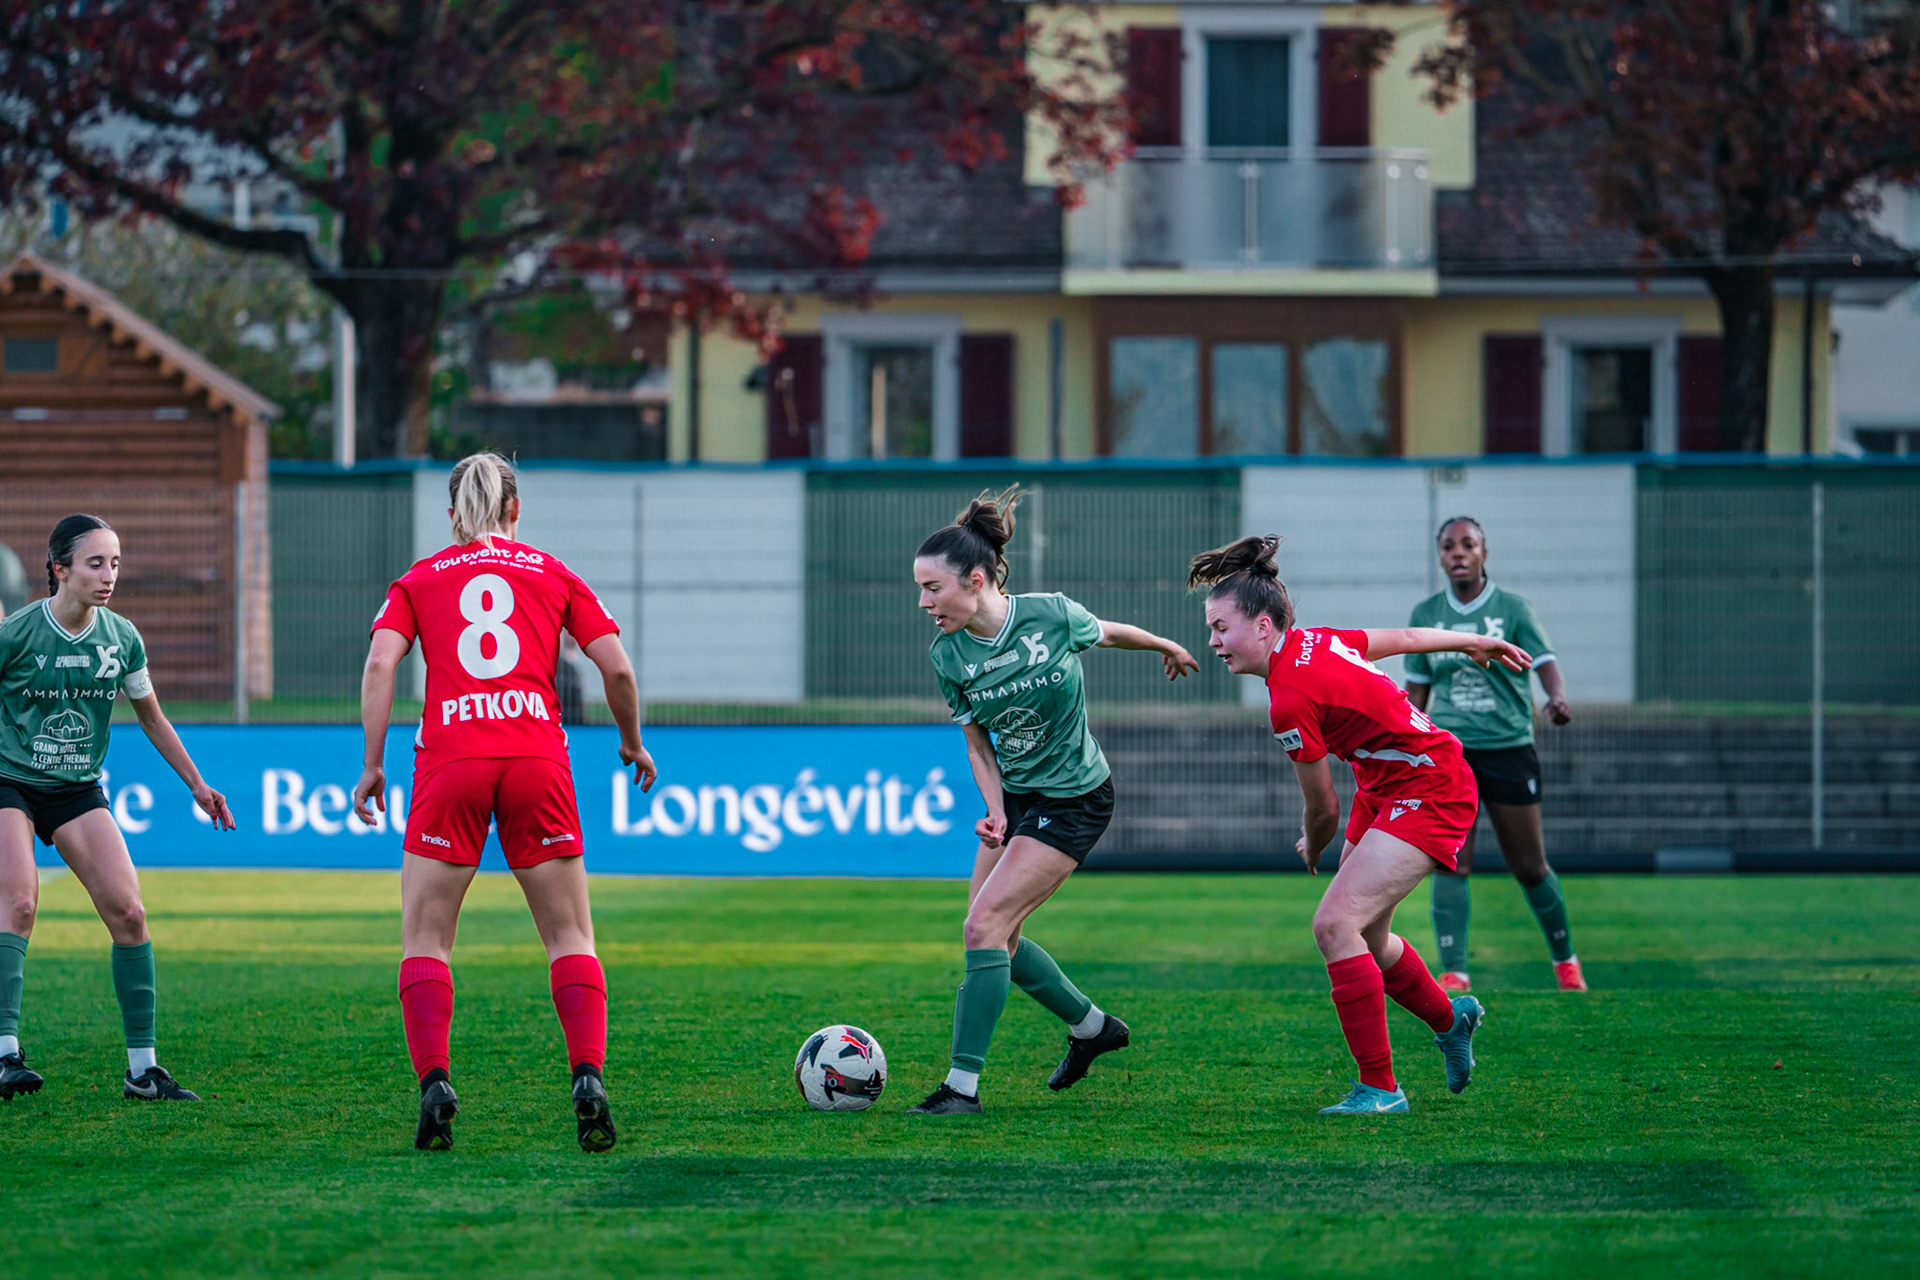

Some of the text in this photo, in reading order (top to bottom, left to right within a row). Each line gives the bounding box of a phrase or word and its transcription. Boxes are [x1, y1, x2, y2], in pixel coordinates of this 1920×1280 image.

[431, 548, 512, 572] Toutvent
[514, 550, 544, 564] AG
[457, 573, 521, 680] 8
[442, 689, 550, 726] PETKOVA
[32, 752, 91, 764] & CENTRE THERMAL
[33, 741, 58, 754] GRAND
[612, 766, 956, 853] Longévité
